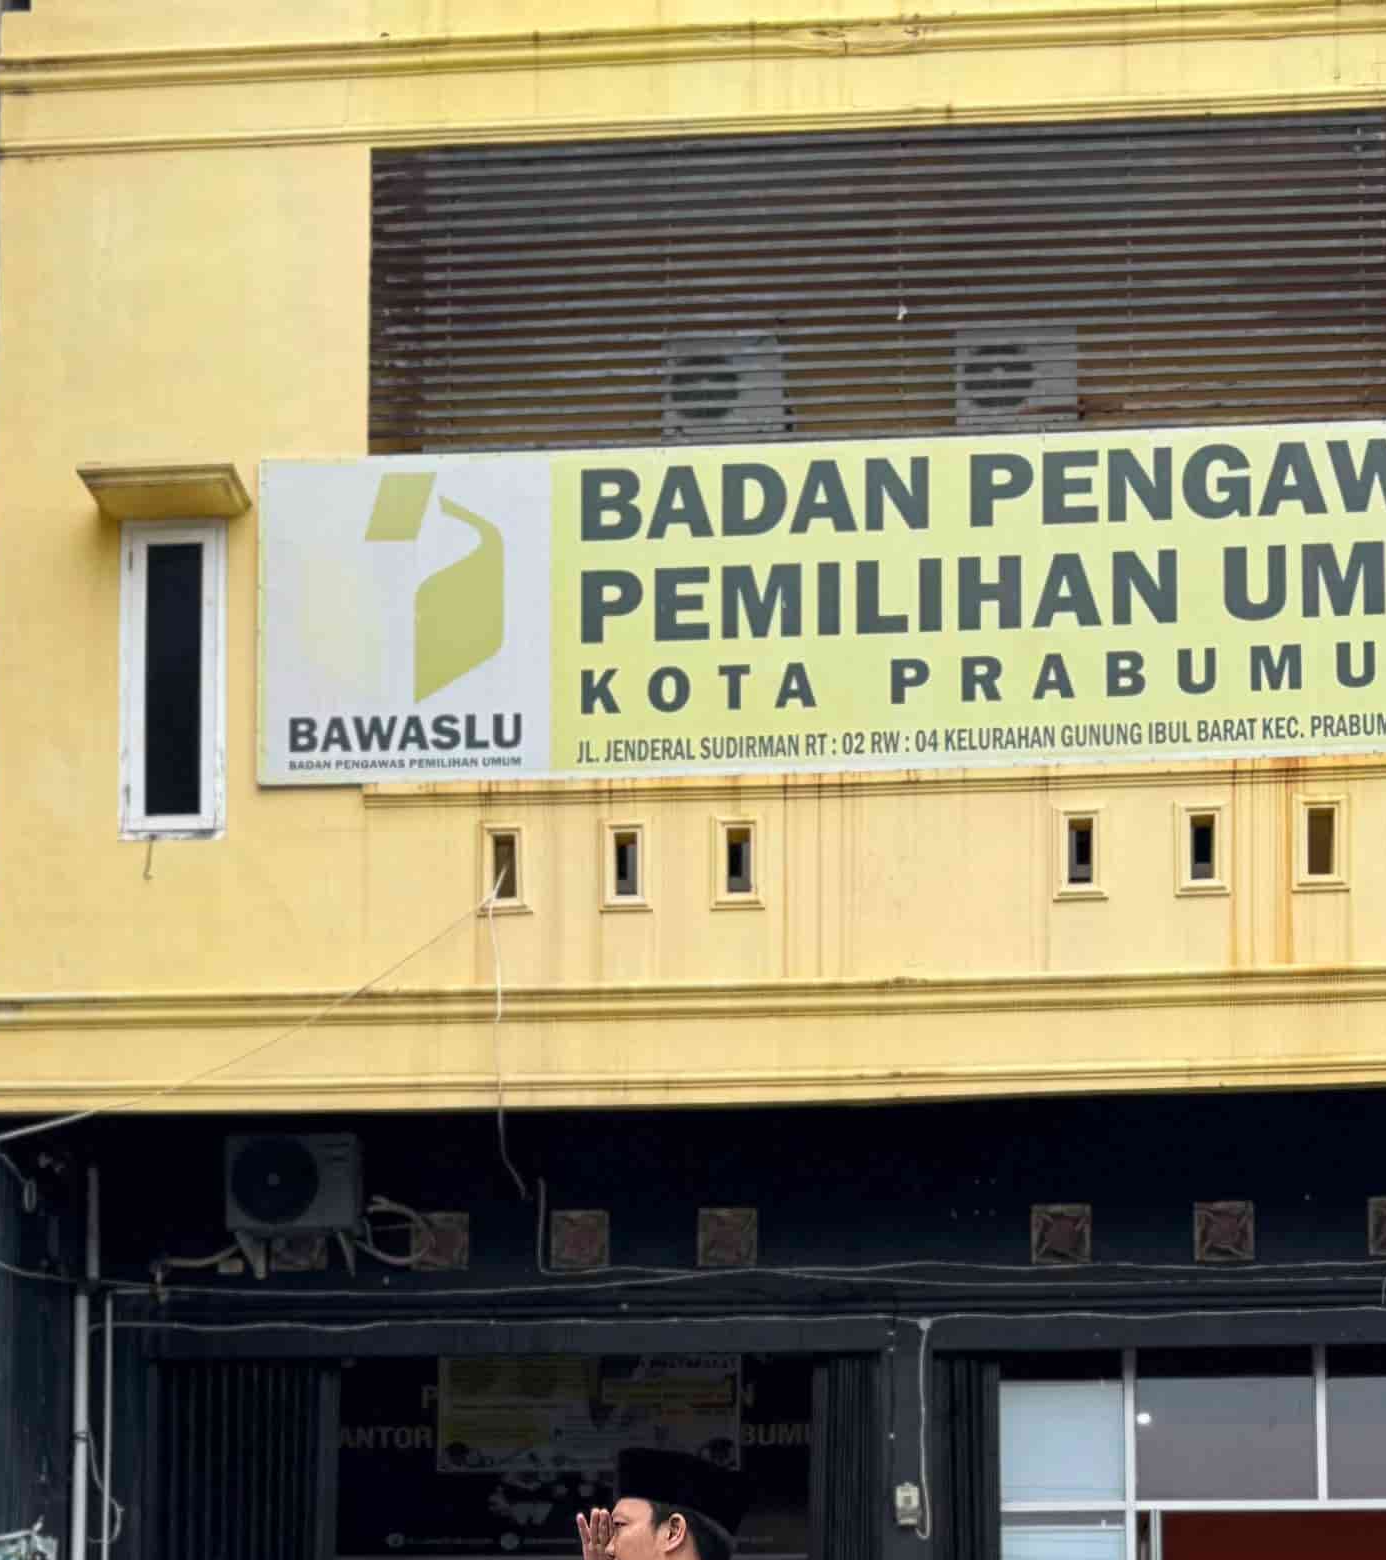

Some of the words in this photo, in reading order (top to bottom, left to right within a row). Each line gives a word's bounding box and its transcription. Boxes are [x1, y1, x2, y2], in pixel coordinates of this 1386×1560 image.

[580, 455, 929, 542] BADAN
[580, 549, 1177, 644] PEMILIHAN
[580, 662, 817, 715] KOTA
[289, 713, 522, 753] BAWASLU
[577, 741, 599, 764] JL.
[604, 738, 696, 763] JENDERAL
[700, 734, 799, 760] SUDIRMAN
[805, 733, 828, 756] RT
[842, 732, 865, 755] 02
[871, 731, 900, 754] RW
[915, 729, 938, 753] 04
[944, 725, 1055, 751] KELURAHAN
[1060, 722, 1142, 747] GUNUNG
[1148, 720, 1192, 745] IBUL
[1197, 717, 1257, 743] BARAT
[1262, 715, 1304, 740] KEC.
[288, 759, 332, 771] BADAN
[335, 758, 406, 771] PENGAWAS
[409, 756, 478, 769] PEMILIHAN
[482, 756, 522, 768] UMUM
[340, 1423, 433, 1449] ANTOR
